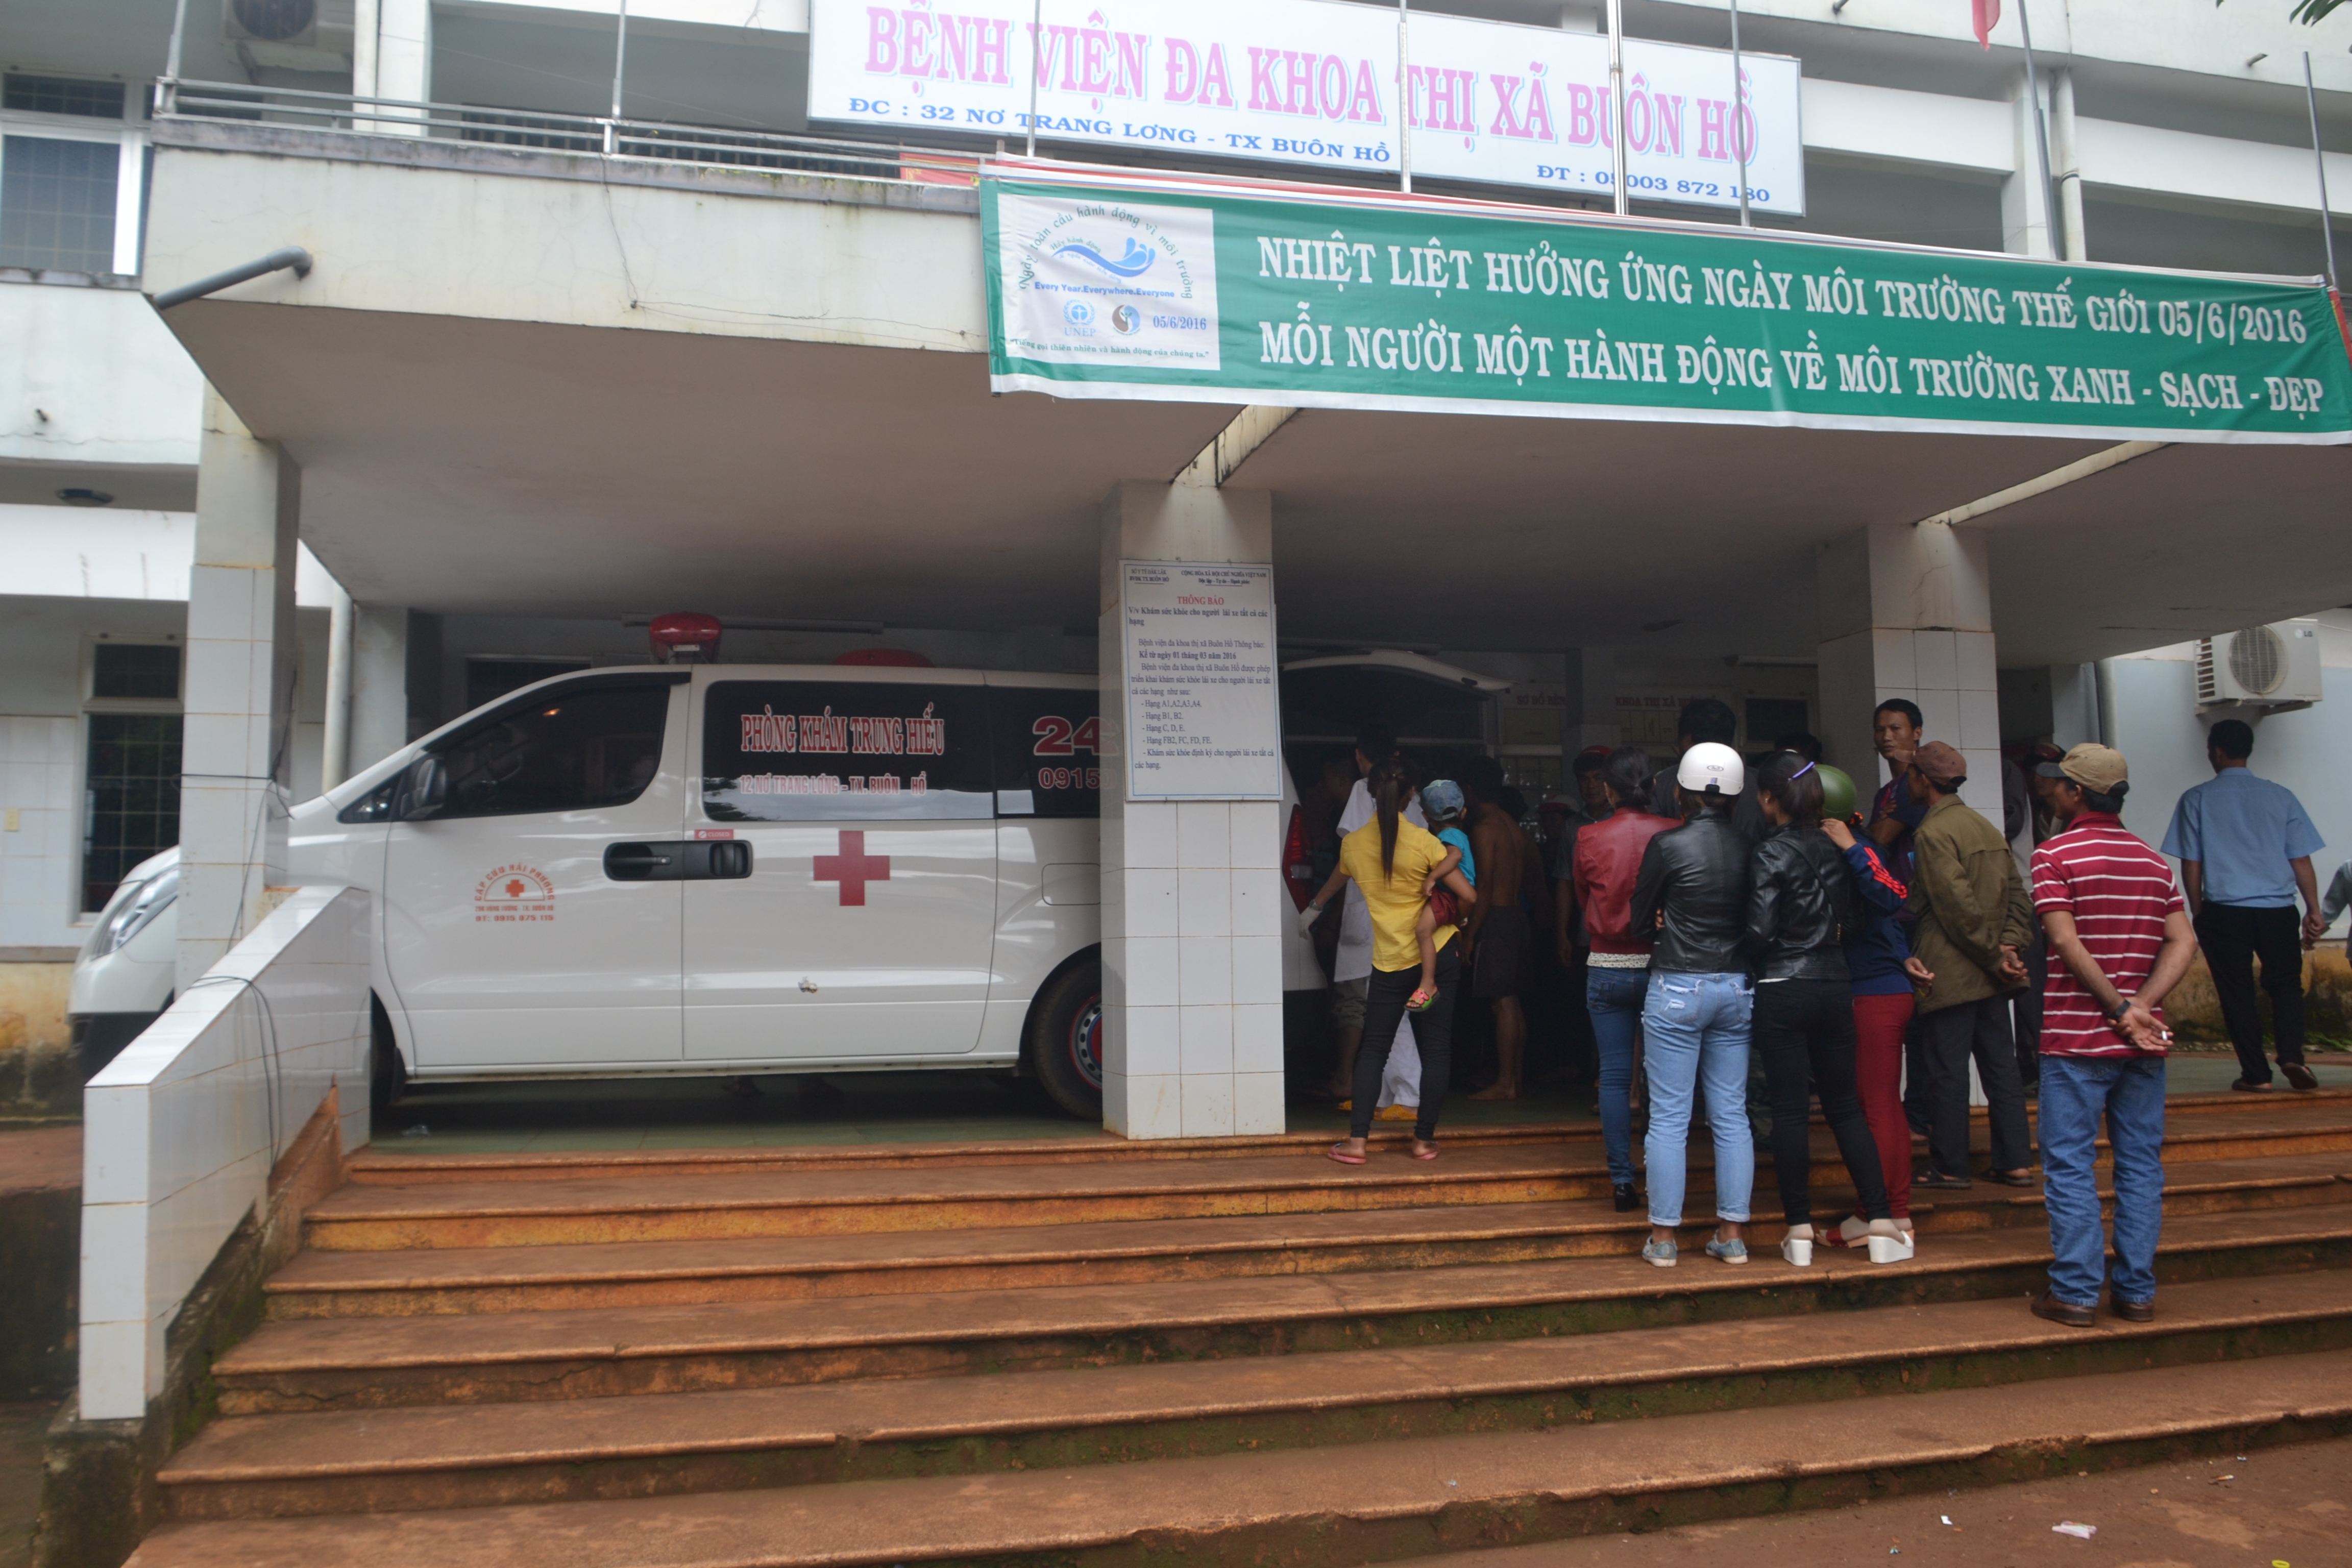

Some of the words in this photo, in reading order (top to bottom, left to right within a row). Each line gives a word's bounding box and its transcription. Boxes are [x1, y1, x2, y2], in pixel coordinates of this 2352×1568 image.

[865, 0, 1013, 96] BỆNH
[1025, 9, 1147, 111] VIỆN
[1164, 37, 1236, 108] ĐA
[1247, 46, 1385, 124] KHOA
[1394, 62, 1475, 150] THỊ
[1490, 60, 1556, 142] XÃ
[1697, 67, 1757, 163] HỒ
[848, 97, 890, 114] ĐC
[921, 105, 954, 120] 32
[966, 108, 1006, 125] NƠ
[1015, 113, 1113, 135] TRANG
[1123, 123, 1197, 143] LƠNG
[1226, 134, 1262, 149] TX
[1272, 137, 1344, 157] BUÔN
[1353, 141, 1390, 162] HỒ
[1537, 164, 1571, 181] ĐT
[1595, 171, 1668, 191] 0003
[1677, 180, 1720, 197] 872
[1729, 185, 1770, 202] 180
[1018, 254, 1039, 289] Ngày
[1030, 227, 1052, 251] toàn
[1053, 212, 1073, 228] cầu
[1077, 205, 1105, 218] hành
[1111, 206, 1140, 228] động
[1146, 223, 1158, 236] vì
[1159, 235, 1179, 256] môi
[1035, 281, 1059, 291] Every
[1061, 284, 1174, 298] Year.Everywhere.Everyone
[1257, 229, 1377, 292] NHIỆT
[1388, 236, 1473, 299] LIỆT
[1484, 240, 1609, 299] HƯỞNG
[1619, 250, 1693, 304] ỨNG
[1701, 259, 1793, 310] NGÀY
[1802, 266, 1868, 315] MÔI
[1875, 274, 2006, 325] TRƯỜNG
[2013, 276, 2078, 329] THẾ
[2086, 288, 2151, 334] GIỚI
[2158, 301, 2307, 346] 05/6/2016
[1153, 315, 1207, 330] 05/6/2016
[1064, 327, 1096, 337] UNEP
[1111, 346, 1131, 354] hành
[1133, 347, 1152, 356] động
[1170, 349, 1194, 358] chúng
[1259, 301, 1334, 366] MỖI
[1345, 317, 1464, 373] NGƯỜI
[1474, 323, 1554, 386] MỘT
[1563, 328, 1668, 383] HÀNH
[1675, 334, 1773, 395] ĐỘNG
[1780, 329, 1827, 391] VỀ
[1836, 344, 1902, 395] MÔI
[1909, 351, 2040, 402] TRƯỜNG
[2046, 364, 2135, 406] XANH
[2159, 371, 2244, 418] SẠCH
[2264, 376, 2324, 421] ĐẸP
[1177, 594, 1206, 605] THÔNG
[1207, 595, 1224, 605] BÁO
[1141, 606, 1160, 615] Khám
[1161, 607, 1172, 615] sức
[1202, 608, 1219, 618] người
[1222, 608, 1231, 616] lái
[1258, 609, 1268, 617] các
[1129, 618, 1144, 626] hạng
[1138, 639, 1154, 647] Bệnh
[1155, 639, 1167, 647] viện
[1176, 639, 1190, 647] khoa
[1191, 640, 1199, 648] thị
[1208, 639, 1223, 648] Buôn
[1224, 638, 1233, 648] Hồ
[1234, 639, 1252, 650] Thông
[1139, 649, 1148, 659] Kể
[1157, 651, 1171, 660] ngày
[1181, 650, 1198, 660] tháng
[1208, 651, 1221, 659] năm
[1145, 700, 1161, 708] Hạng
[1615, 696, 1641, 706] KHOA
[1145, 712, 1161, 720] Hạng
[1162, 712, 1172, 720] B1,
[741, 704, 797, 753] PHÒNG
[799, 705, 848, 753] KHÁM
[849, 716, 904, 755] TRUNG
[905, 701, 945, 755] HIẾU
[1146, 724, 1162, 732] Hạng
[1146, 737, 1162, 745] Hạng
[740, 775, 753, 794] 12
[773, 775, 809, 794] TRANG
[848, 776, 867, 795] TX.
[869, 773, 900, 795] BUÔN
[911, 771, 926, 795] HỒ
